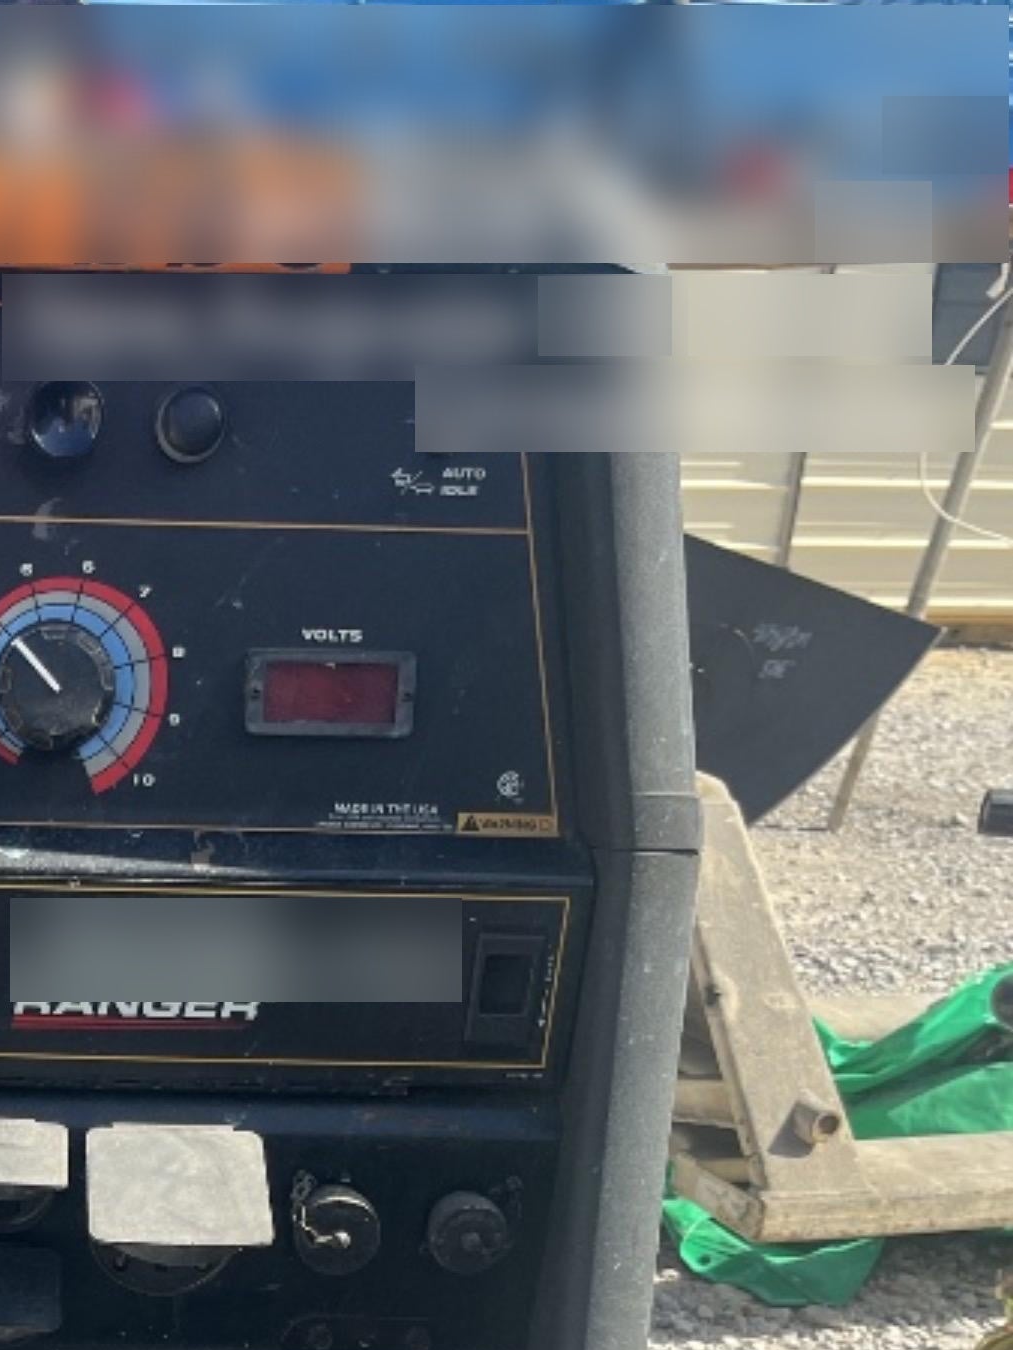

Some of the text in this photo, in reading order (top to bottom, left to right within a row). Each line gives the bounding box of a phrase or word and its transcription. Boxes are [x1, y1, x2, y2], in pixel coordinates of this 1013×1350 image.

[442, 467, 486, 480] AUTO
[440, 485, 478, 496] IDLE
[139, 585, 153, 599] 7
[301, 627, 363, 643] VOLTS
[169, 714, 181, 726] 9
[133, 774, 156, 787] 10
